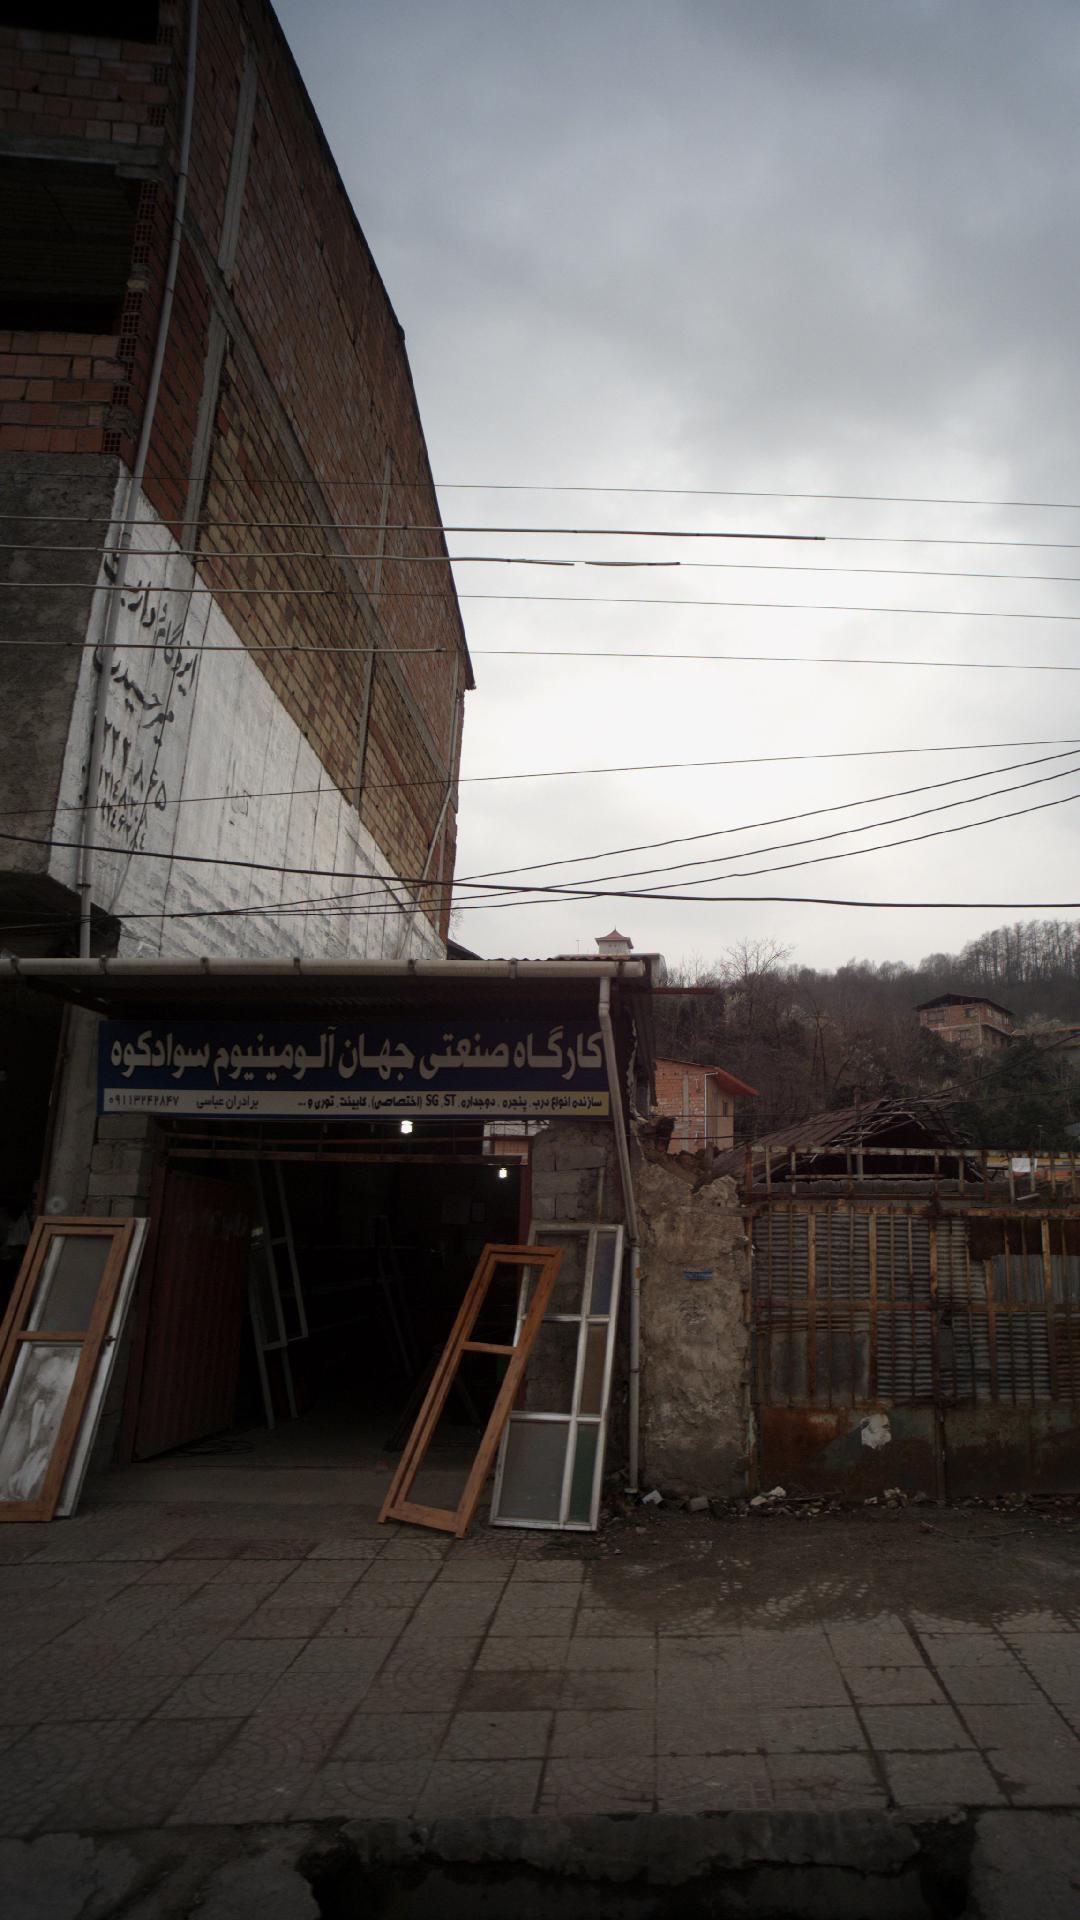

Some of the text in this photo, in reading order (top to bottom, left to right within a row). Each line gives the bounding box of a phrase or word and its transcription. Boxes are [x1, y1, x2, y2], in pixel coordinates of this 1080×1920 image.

[110, 1025, 604, 1088] کارگاه صنعتی جهان آلومینیوم سوادکوه
[196, 1096, 259, 1110] برادران عباسی
[551, 1096, 571, 1110] انواع
[572, 1096, 602, 1109] سازنده
